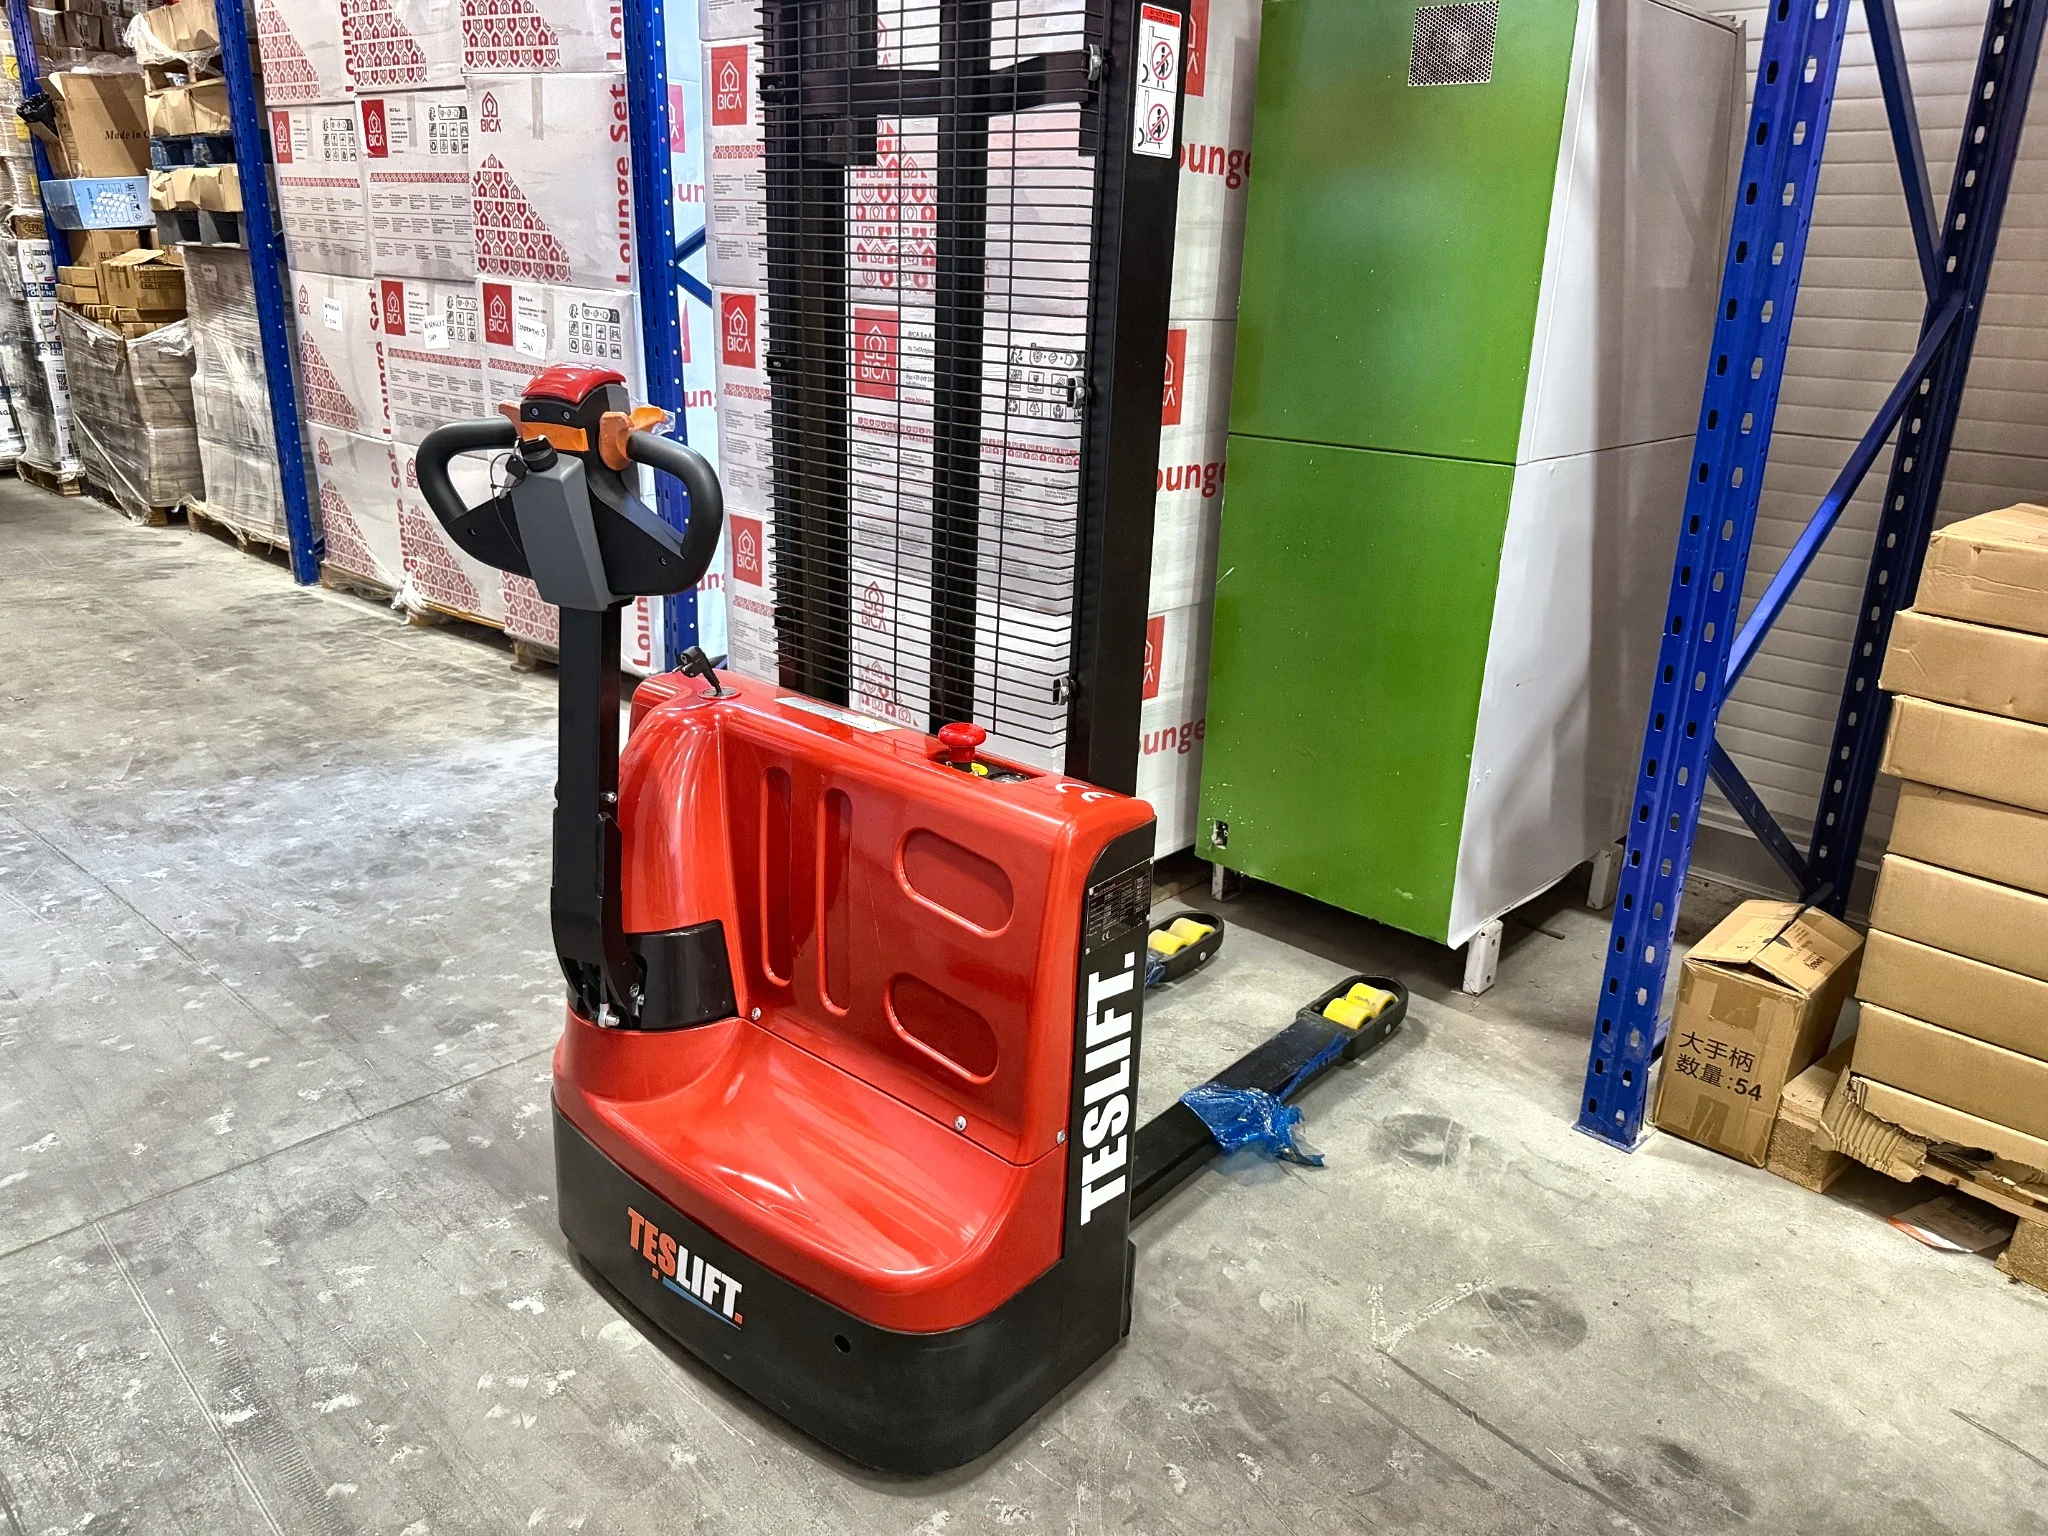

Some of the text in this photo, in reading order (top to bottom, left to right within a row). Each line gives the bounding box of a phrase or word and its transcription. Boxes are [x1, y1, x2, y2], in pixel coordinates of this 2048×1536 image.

[718, 94, 742, 111] BICA
[609, 83, 629, 143] Set
[480, 118, 502, 132] BICA
[105, 130, 130, 140] Made
[132, 130, 141, 139] in
[368, 134, 385, 147] BICA
[277, 141, 291, 154] BICA
[299, 303, 311, 316] BICA
[386, 312, 403, 326] BICA
[489, 318, 510, 334] BICA
[727, 336, 751, 354] BICA
[861, 360, 890, 382] BICA
[685, 389, 717, 412] un
[318, 454, 334, 467] BICA
[736, 553, 759, 573] BICA
[861, 608, 887, 632] BICA
[1138, 718, 1205, 756] unge
[1678, 1031, 1756, 1073] 大手柄
[1080, 950, 1136, 1227] TESLIFT.
